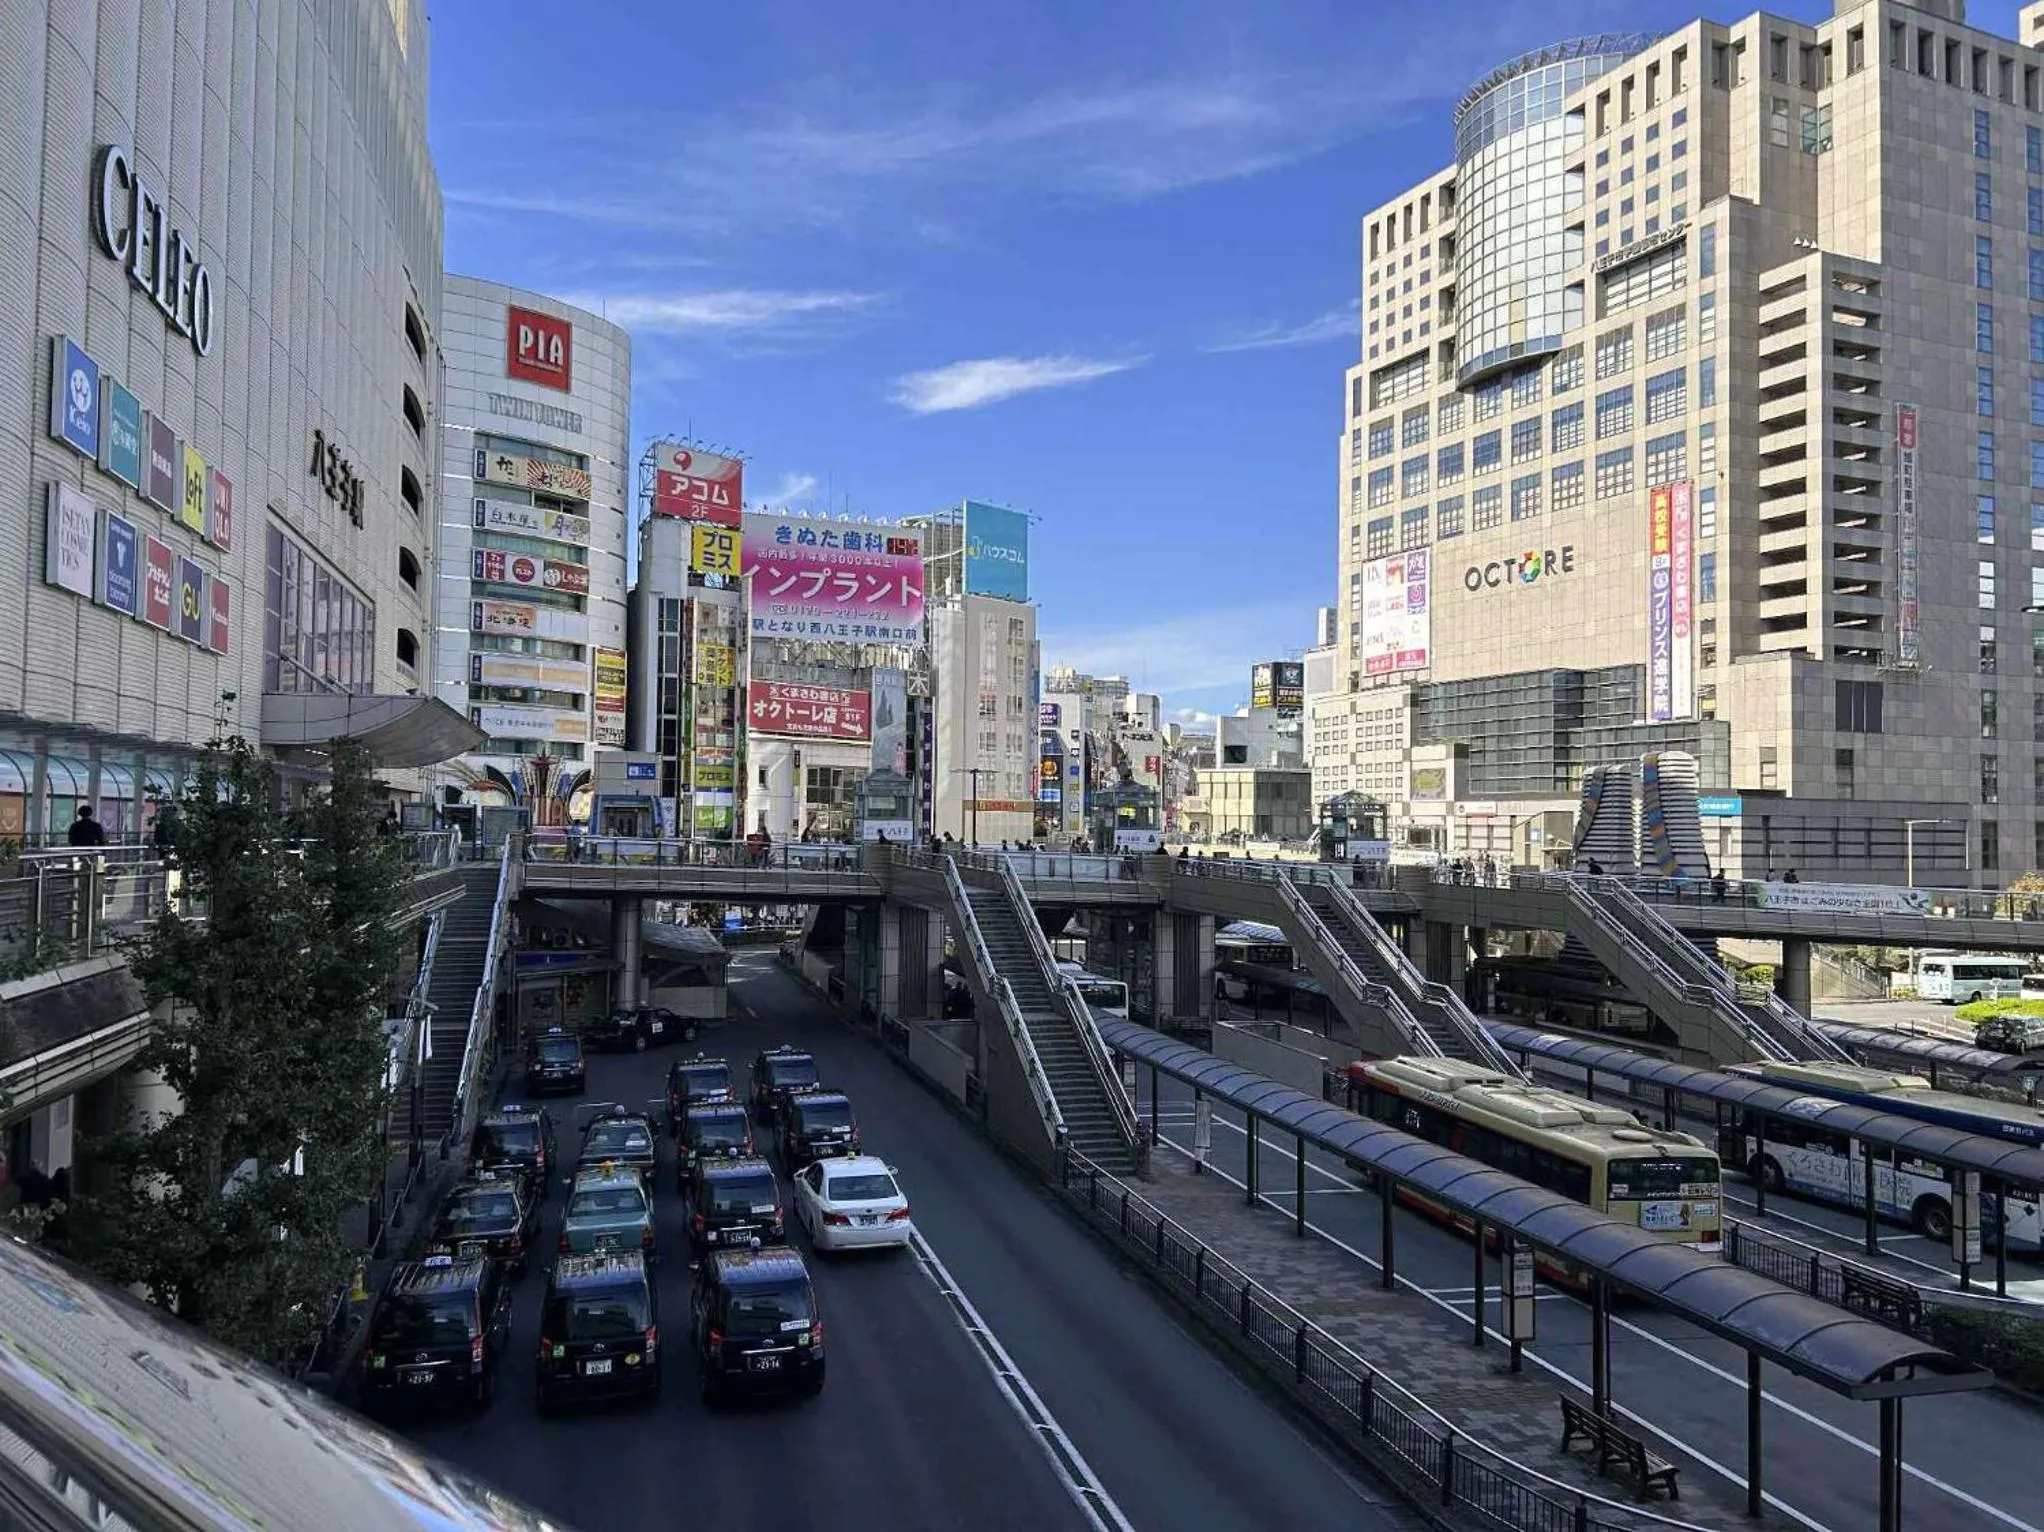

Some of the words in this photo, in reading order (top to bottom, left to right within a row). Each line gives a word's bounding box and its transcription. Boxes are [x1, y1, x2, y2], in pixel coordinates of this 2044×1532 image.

[100, 145, 213, 357] CELEO
[518, 323, 565, 366] PIA
[670, 475, 729, 505] アコム
[703, 531, 733, 551] プロ
[775, 525, 884, 553] きぬた歯科
[703, 552, 733, 571] ミス
[983, 543, 1025, 564] ハウスコム
[182, 582, 200, 621] GU
[753, 699, 838, 724] オクトーレ店
